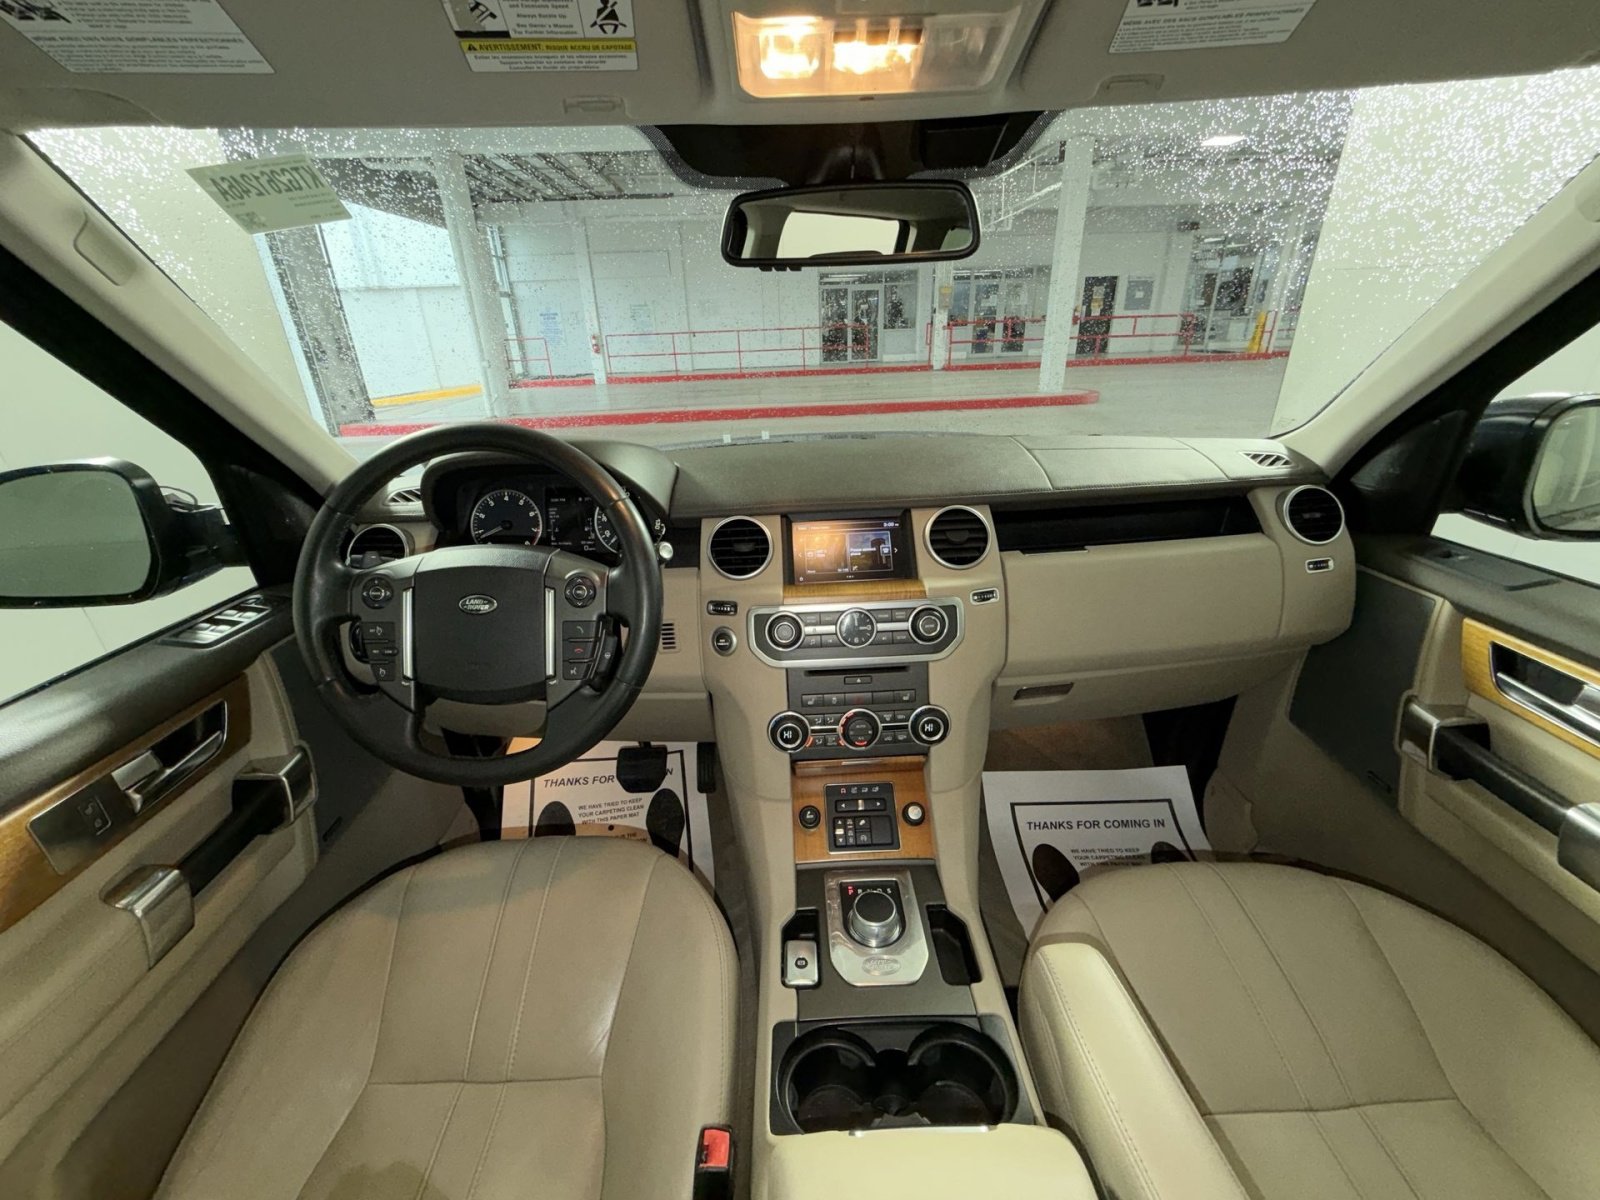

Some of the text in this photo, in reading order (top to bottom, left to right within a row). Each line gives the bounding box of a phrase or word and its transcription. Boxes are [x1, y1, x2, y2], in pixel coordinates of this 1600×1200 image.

[783, 731, 792, 739] HI
[543, 776, 589, 788] THANKS
[592, 774, 615, 785] FOR
[594, 807, 626, 816] CARPETING
[626, 804, 645, 812] CLEAN
[1027, 818, 1166, 830] THANKS FOR COMING IN
